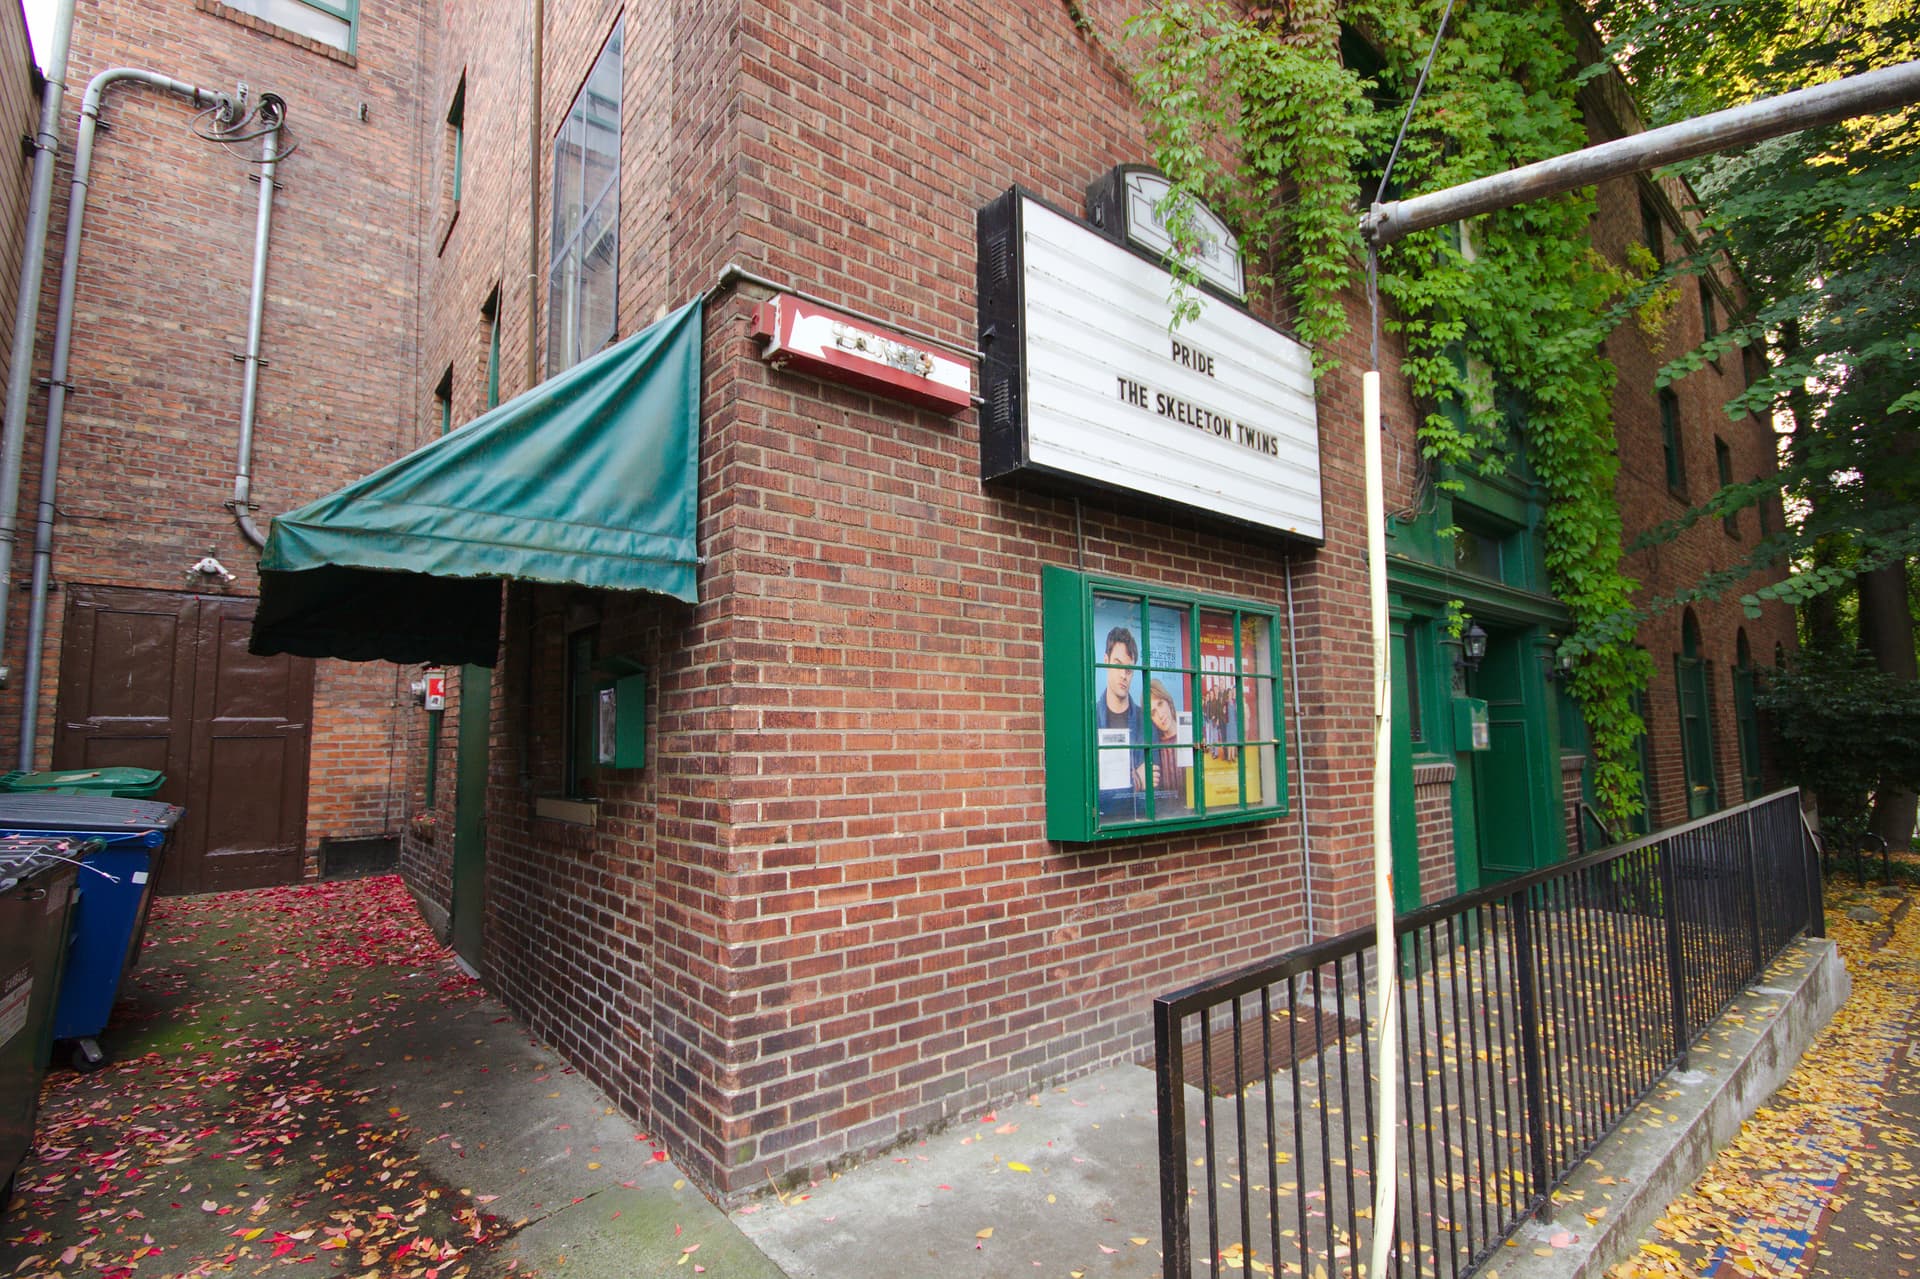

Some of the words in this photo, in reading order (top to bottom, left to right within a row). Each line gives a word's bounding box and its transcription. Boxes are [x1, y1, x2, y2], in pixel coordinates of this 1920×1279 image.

[1172, 341, 1215, 377] PRIDE
[1117, 377, 1148, 409] THE
[1156, 393, 1232, 440] SKELETON
[1236, 423, 1279, 456] TWINS
